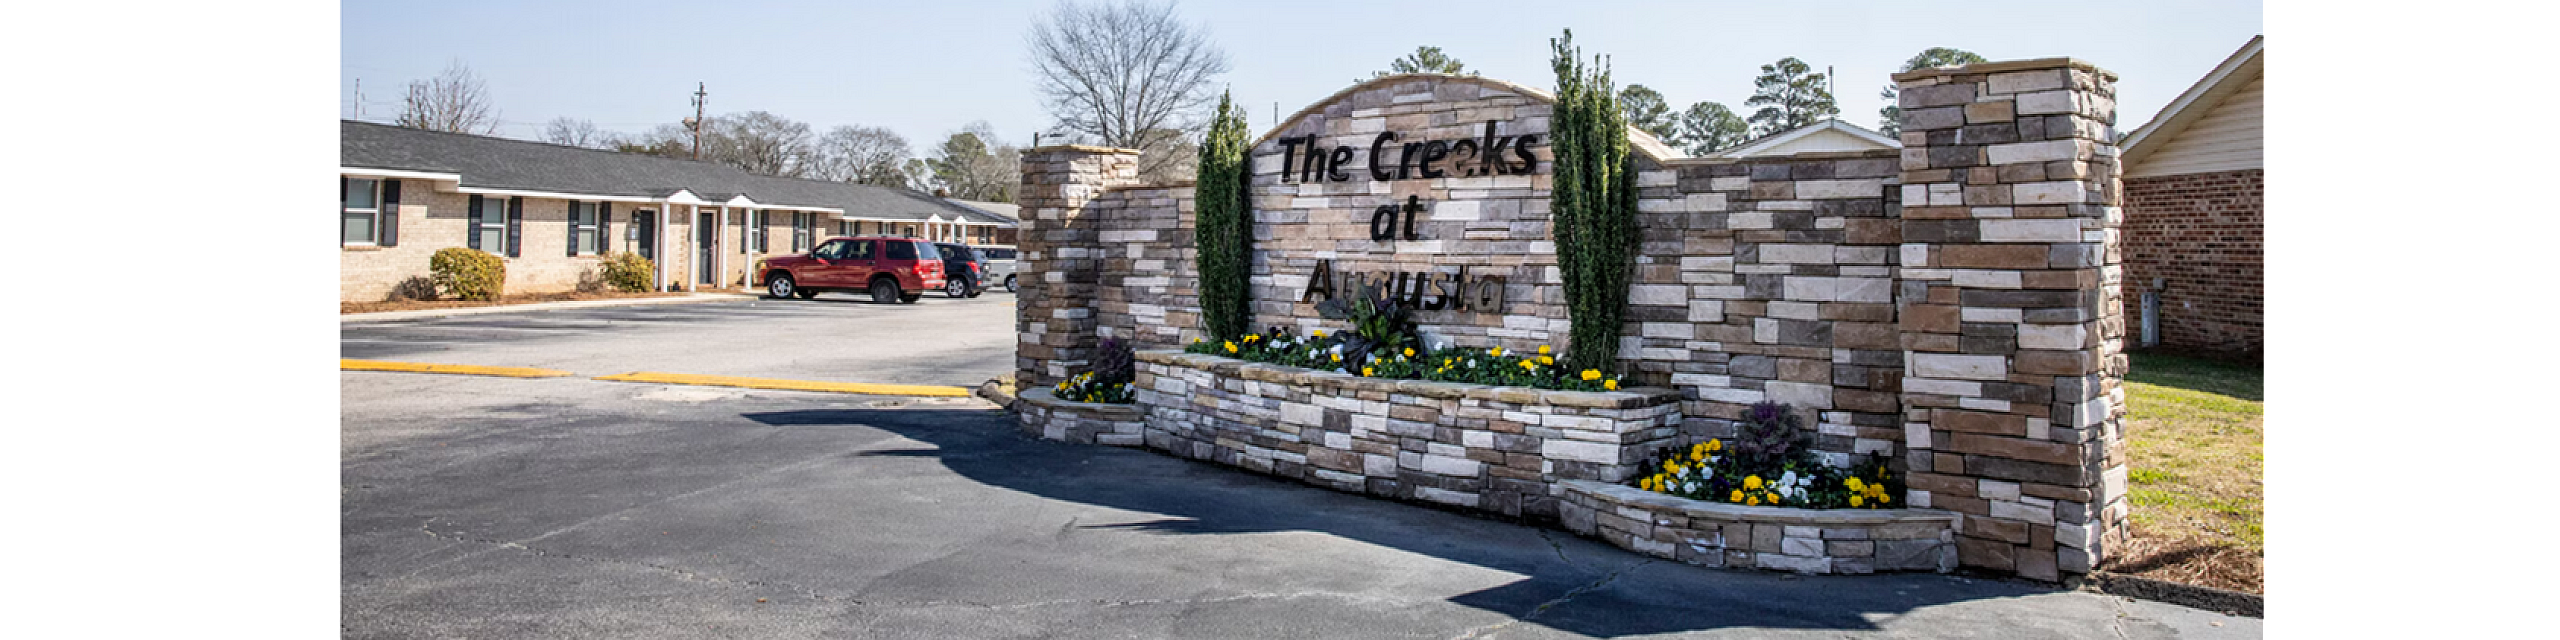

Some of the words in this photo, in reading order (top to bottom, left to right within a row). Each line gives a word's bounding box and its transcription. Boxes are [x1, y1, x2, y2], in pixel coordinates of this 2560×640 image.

[1279, 134, 1353, 182] The
[1370, 119, 1538, 181] Creeks
[1372, 195, 1426, 242] at
